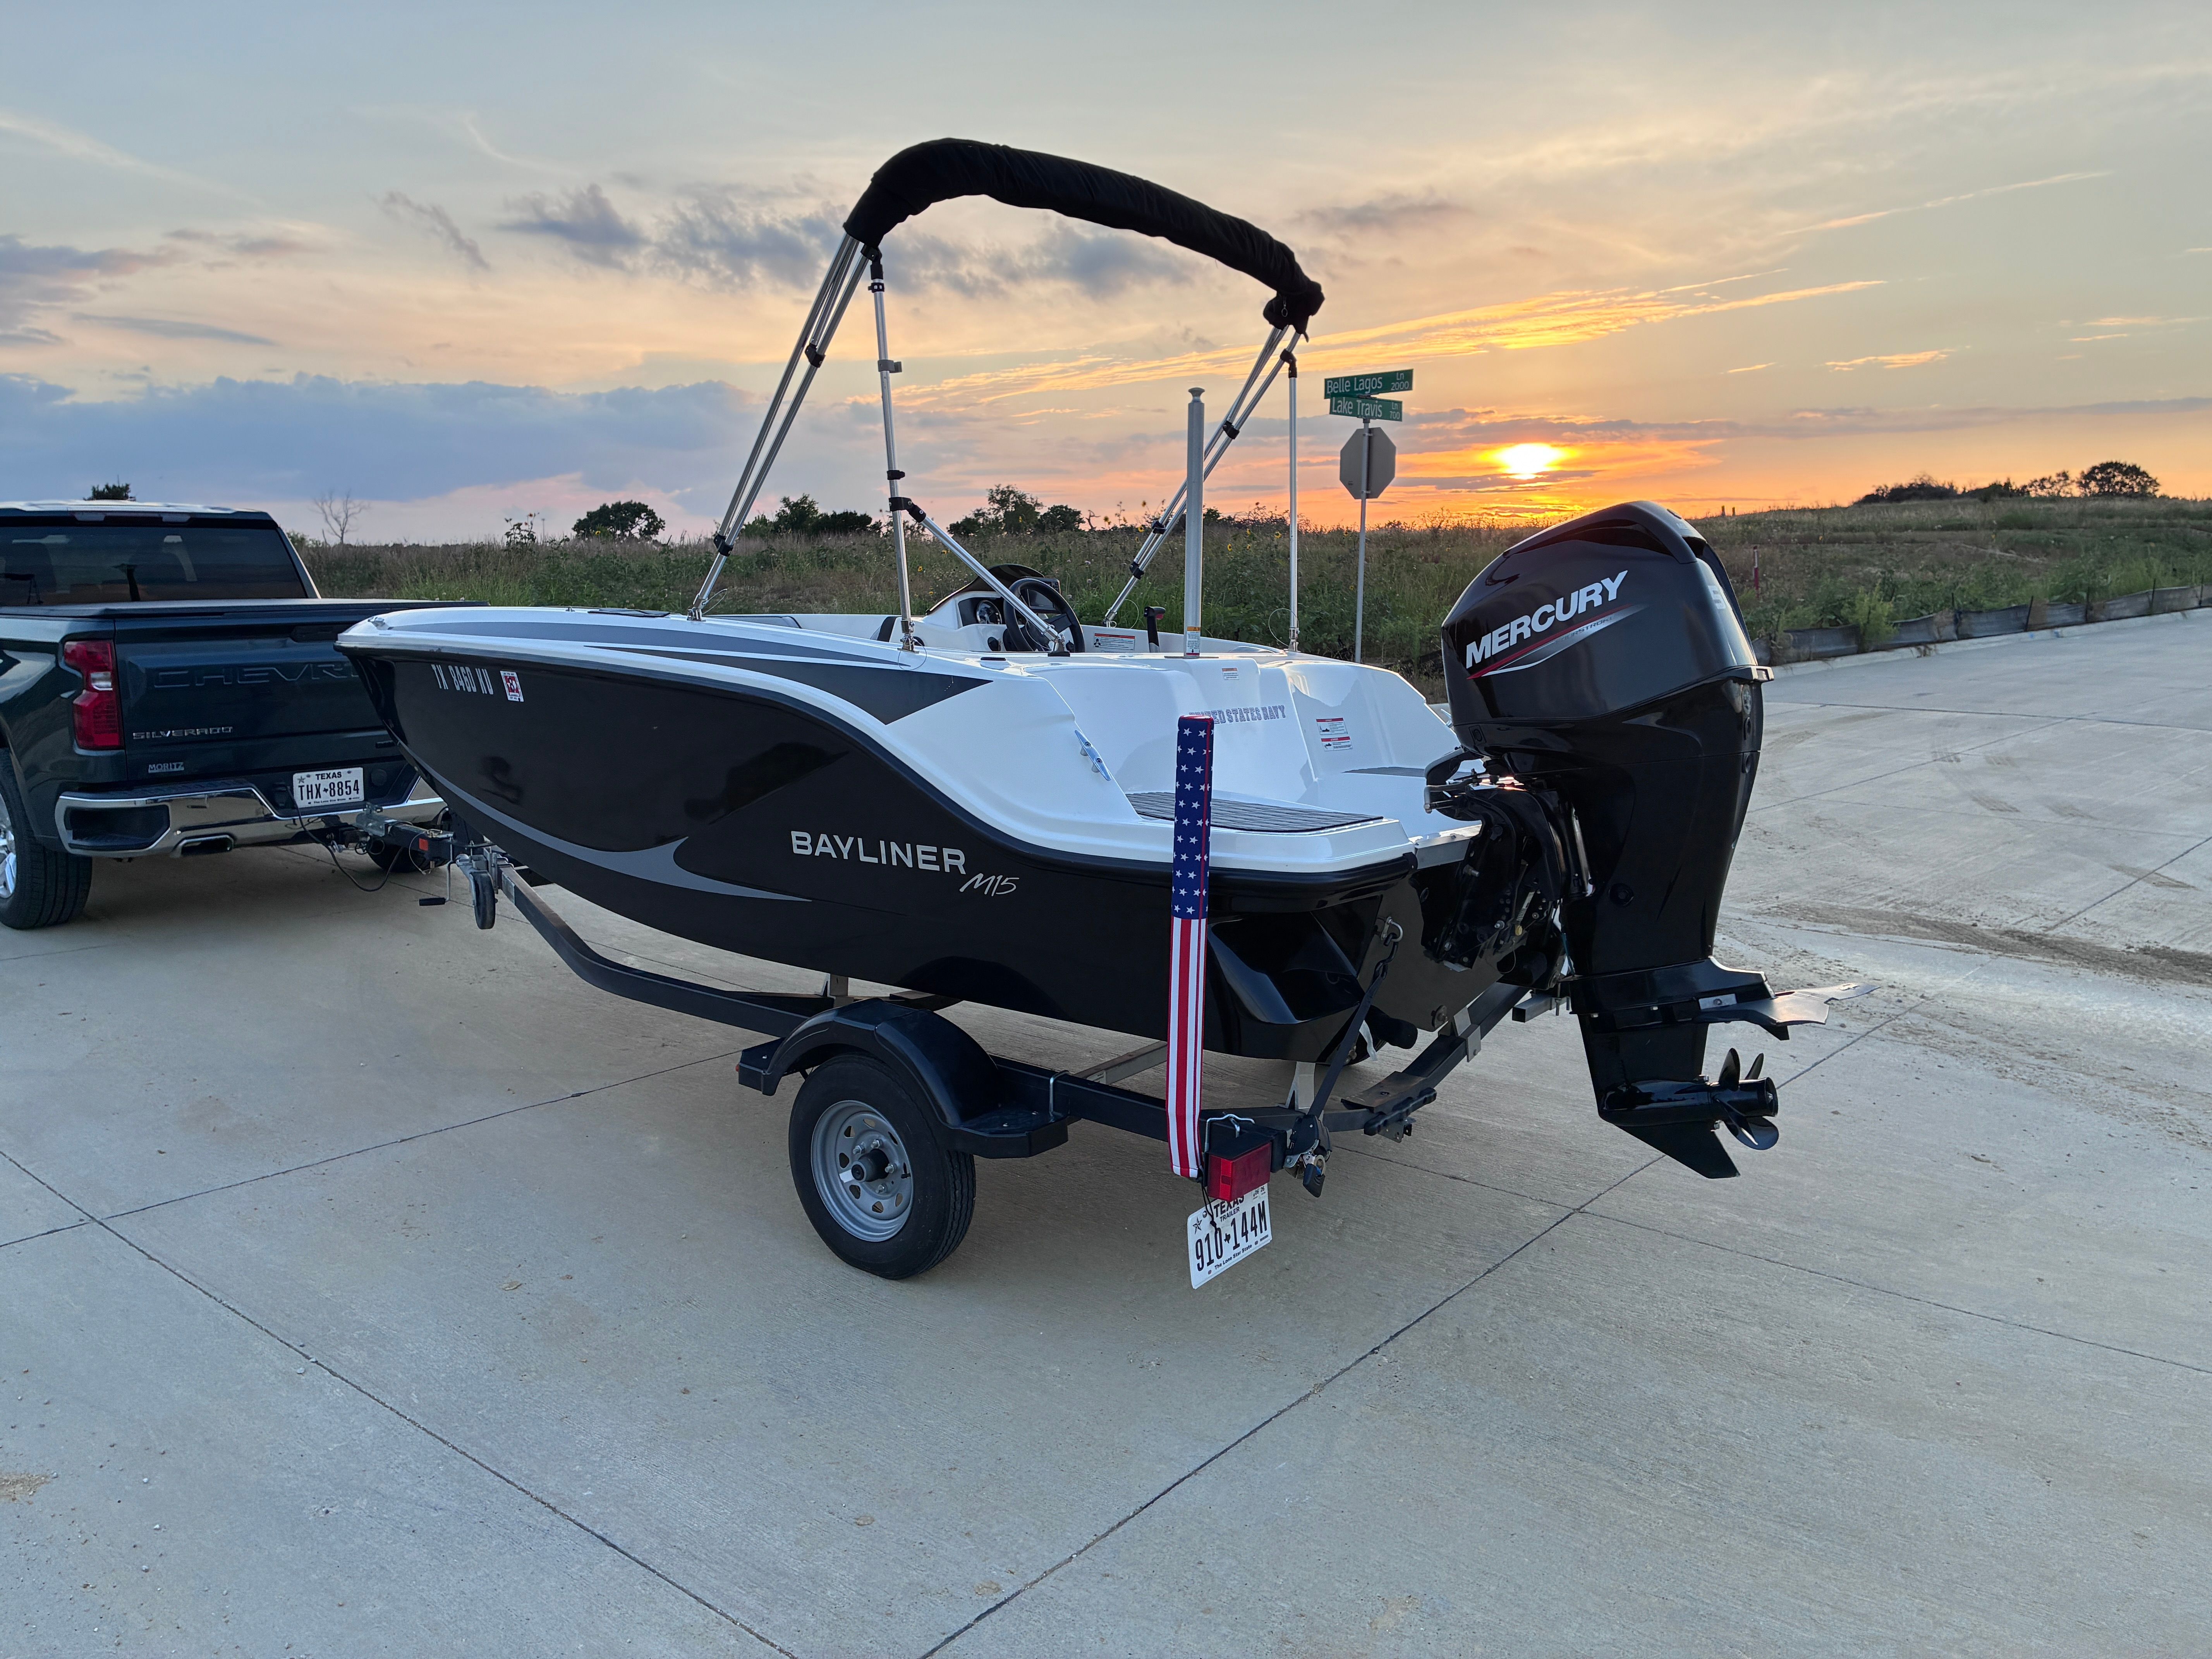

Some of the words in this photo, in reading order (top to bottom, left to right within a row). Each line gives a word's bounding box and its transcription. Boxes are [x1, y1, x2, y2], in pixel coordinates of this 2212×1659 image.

[1327, 378, 1350, 394] Belle
[1354, 377, 1382, 394] Lagos
[1391, 381, 1409, 391] 2000
[1332, 397, 1353, 414] Lake
[1357, 399, 1382, 417] Travis
[1389, 410, 1400, 419] 700
[1466, 570, 1628, 669] MERCURY
[431, 664, 448, 690] TX
[448, 665, 477, 692] 8460
[1226, 707, 1262, 723] STATES
[1261, 705, 1286, 720] NAVY
[133, 726, 233, 740] SILVERADO
[148, 762, 184, 773] MORITZ
[315, 771, 342, 780] TEXAS
[298, 783, 321, 800] THX
[329, 780, 359, 797] 8854
[791, 831, 966, 874] BAYLINER
[959, 873, 1019, 896] M15
[1220, 1207, 1240, 1222] TRAILER
[1195, 1228, 1223, 1272] 910
[1231, 1200, 1267, 1250] 144M
[1223, 1257, 1232, 1265] Lone
[1242, 1244, 1252, 1253] State
